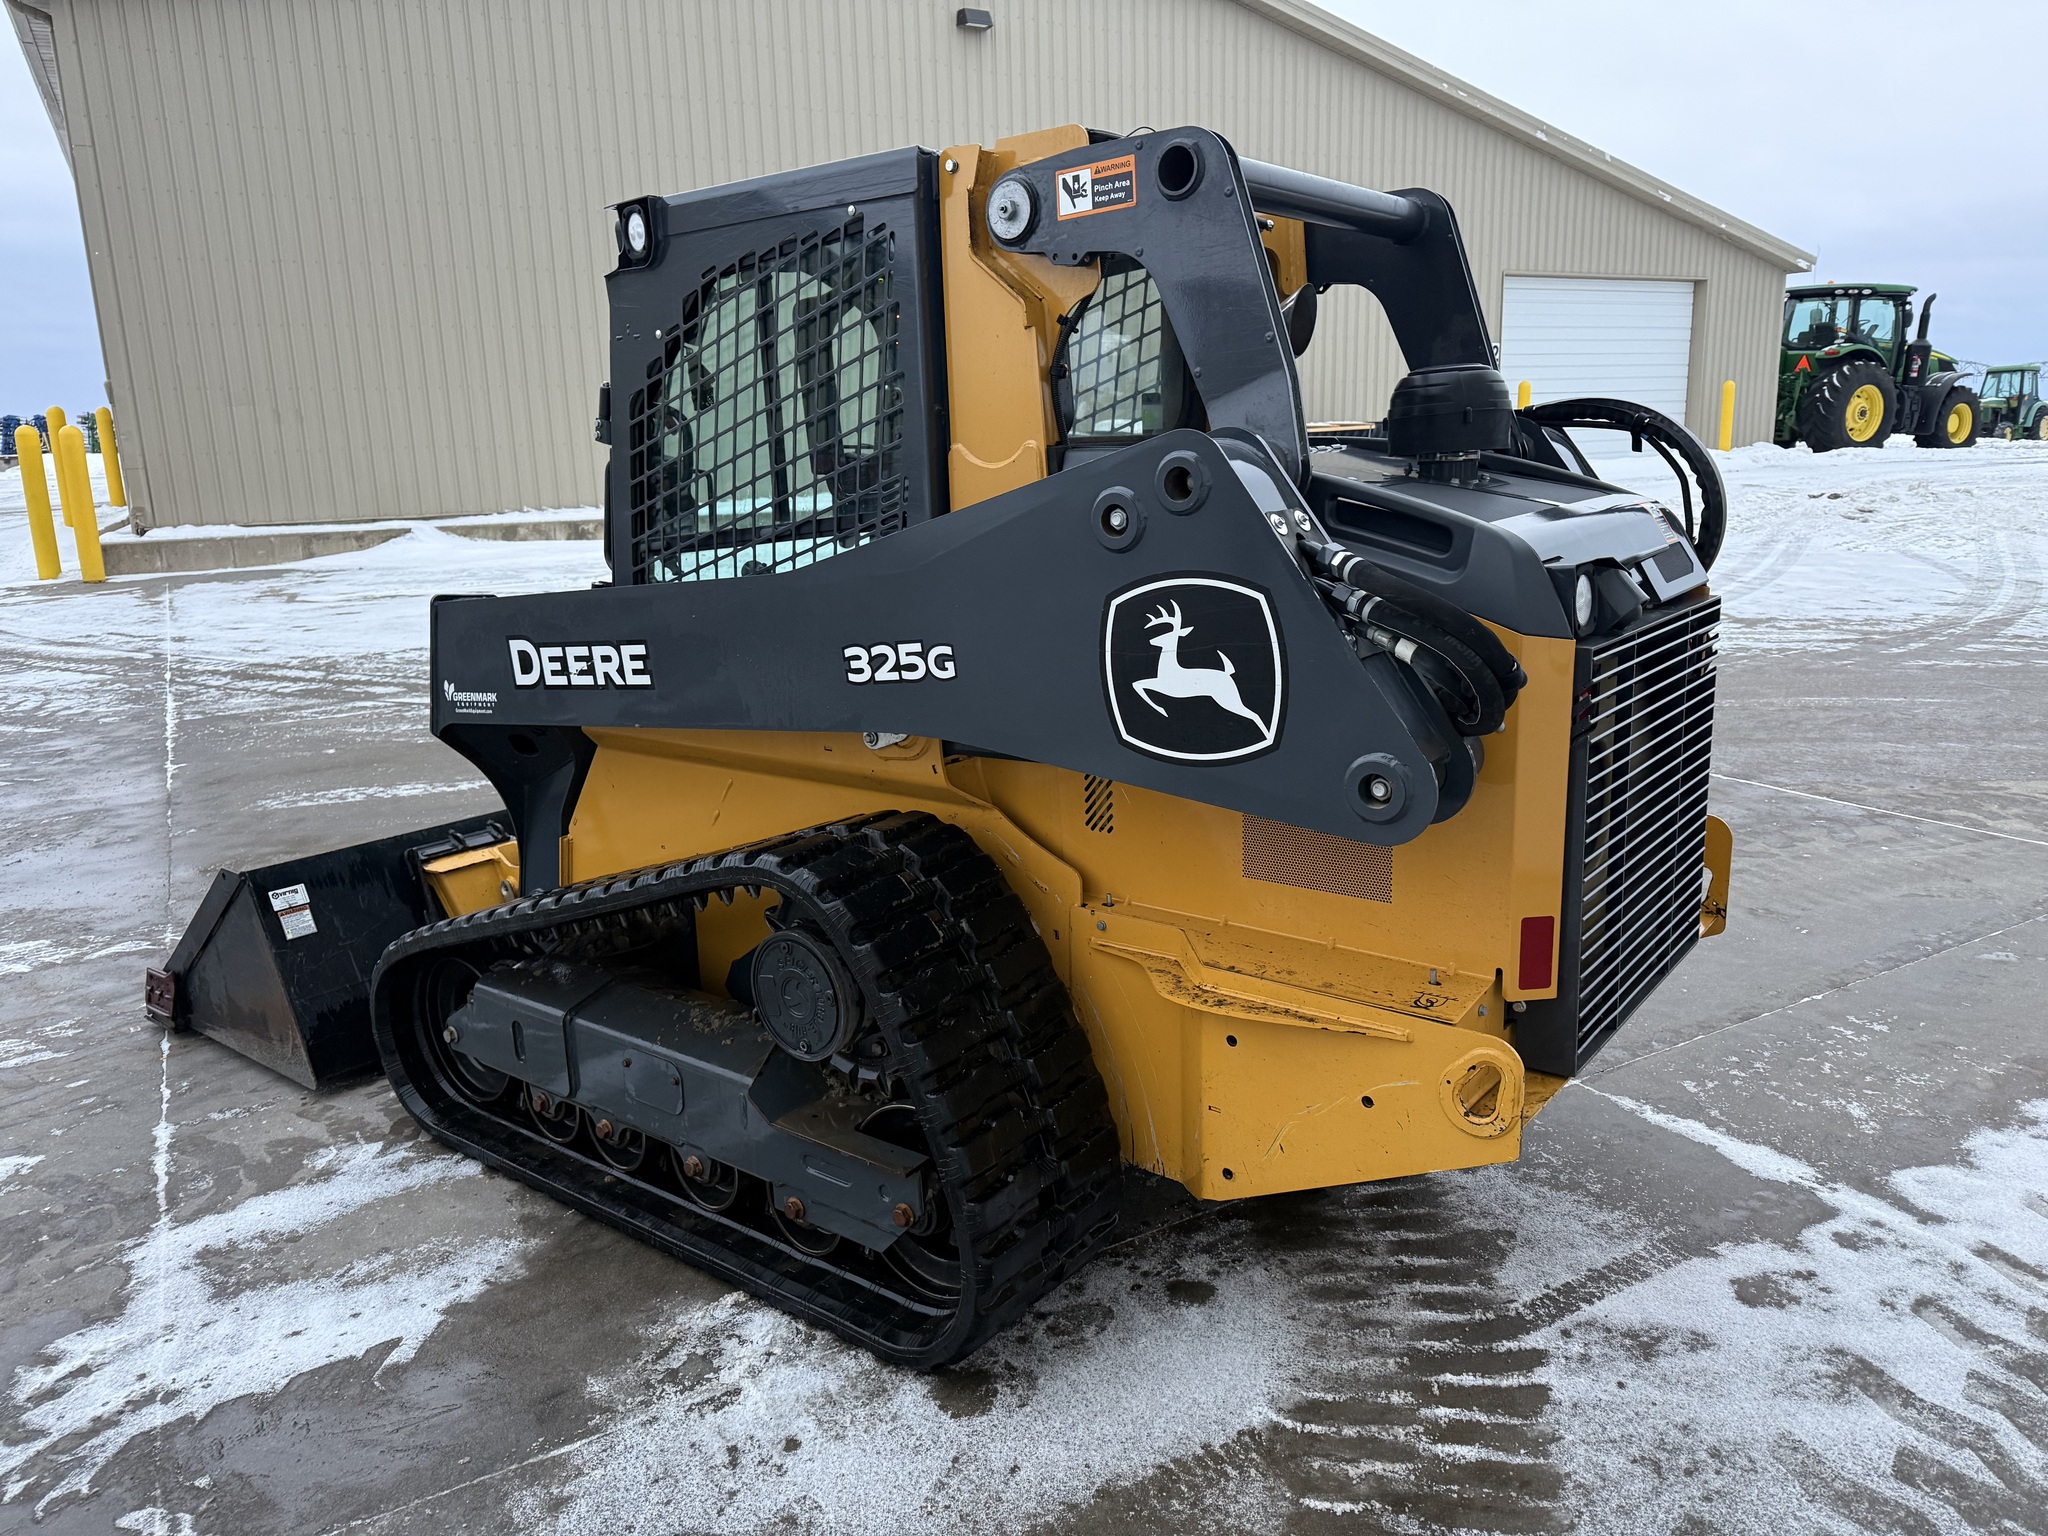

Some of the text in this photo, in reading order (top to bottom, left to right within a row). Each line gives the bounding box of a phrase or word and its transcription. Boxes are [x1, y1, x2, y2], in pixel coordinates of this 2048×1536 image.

[1101, 160, 1131, 173] WARNING
[1094, 179, 1131, 193] Pinch Area
[1094, 194, 1110, 203] Keep
[1110, 191, 1126, 200] Away
[508, 639, 652, 686] DEERE
[843, 642, 956, 683] 325G
[452, 691, 498, 702] GREENMARK
